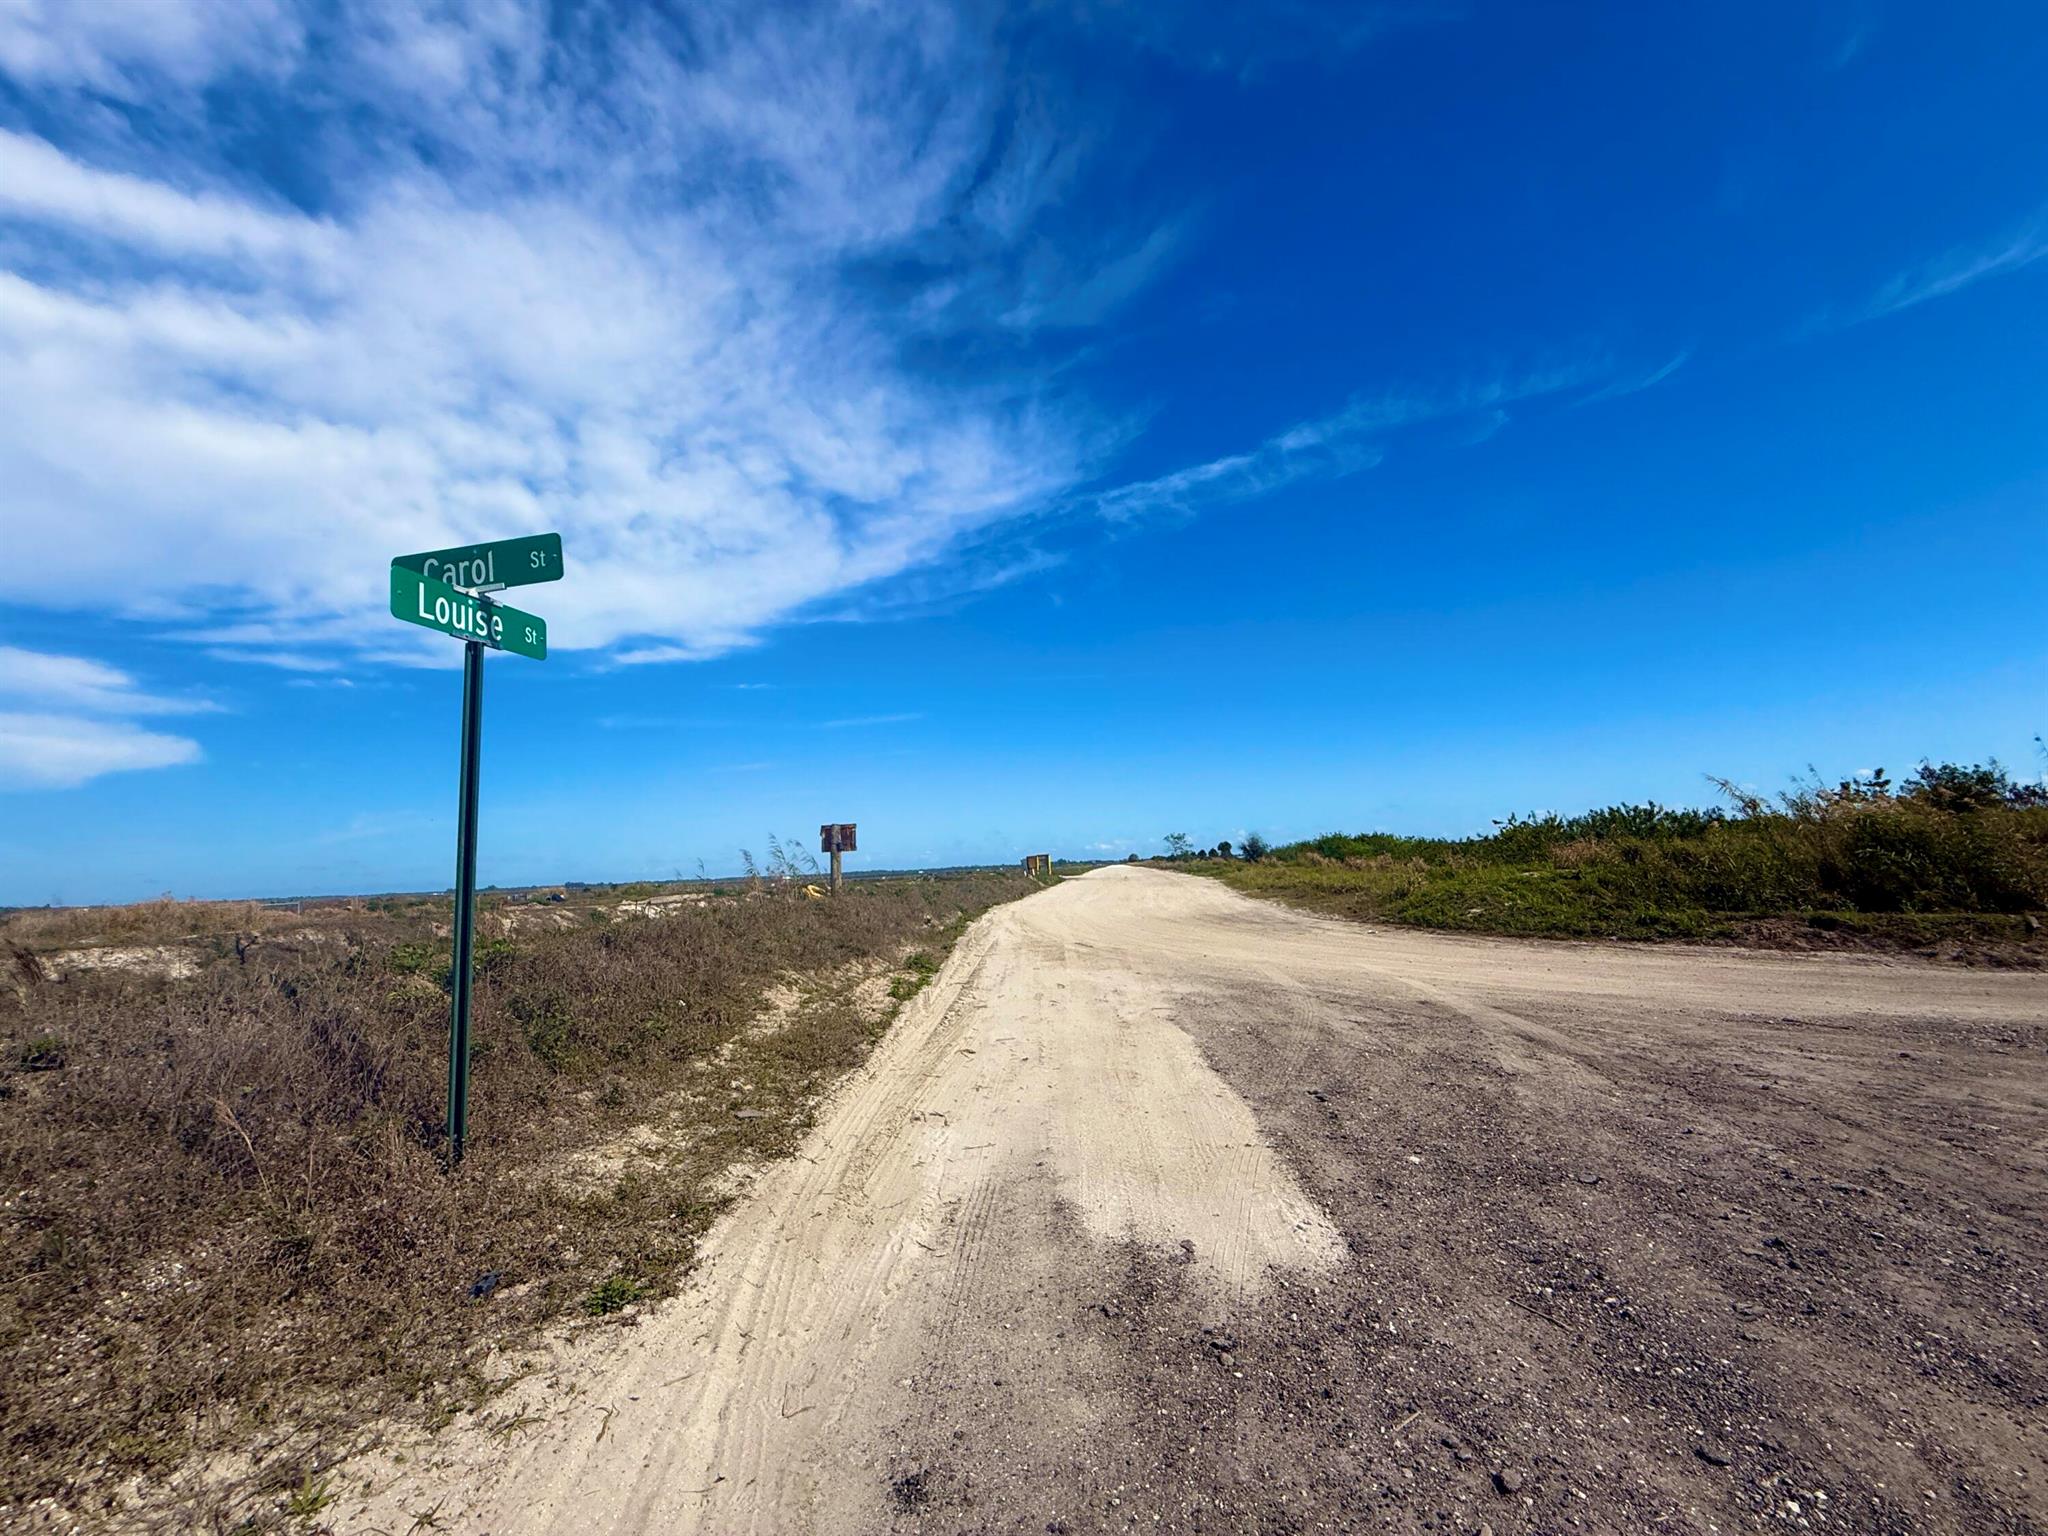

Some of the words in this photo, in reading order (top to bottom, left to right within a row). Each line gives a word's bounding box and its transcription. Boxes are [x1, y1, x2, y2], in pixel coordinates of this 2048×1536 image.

[423, 550, 494, 586] Carol
[530, 550, 546, 568] St
[419, 581, 503, 641] Louise
[525, 626, 537, 645] St
